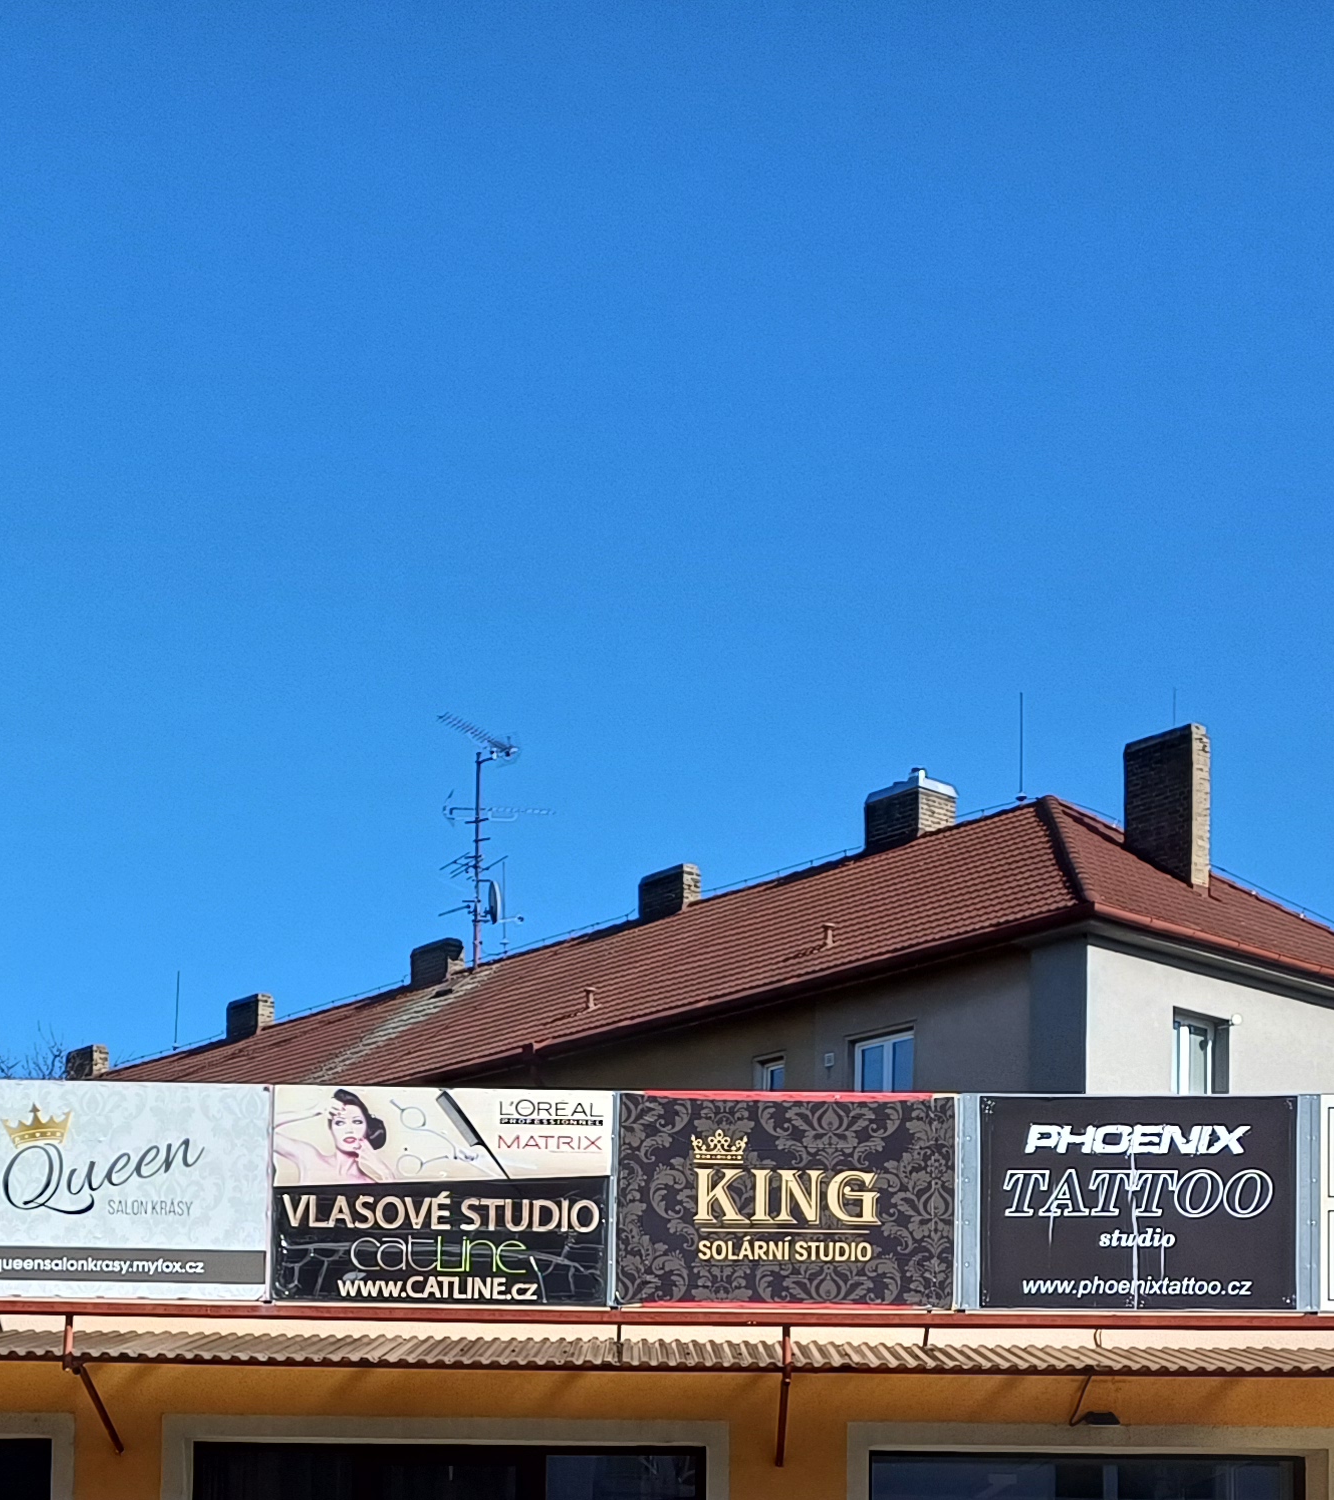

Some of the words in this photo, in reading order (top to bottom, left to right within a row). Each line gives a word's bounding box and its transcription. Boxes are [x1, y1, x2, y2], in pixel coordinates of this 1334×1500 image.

[499, 1117, 603, 1126] PROFESSIONNEL
[497, 1134, 603, 1151] MATRIX
[1024, 1123, 1252, 1155] PHOENIX
[2, 1137, 206, 1215] Queen
[693, 1167, 882, 1226] KING
[1002, 1168, 1274, 1219] TATTOO
[107, 1199, 148, 1216] SALON
[151, 1197, 194, 1217] KRÁSY
[283, 1191, 452, 1231] VLASOVÉ
[460, 1198, 601, 1234] STUDIO
[698, 1236, 792, 1260] SOLÁRNÍ
[795, 1240, 872, 1261] STUDIO
[1099, 1227, 1177, 1248] studio
[337, 1275, 538, 1300] www.CATLINE.cz
[1022, 1276, 1253, 1298] www.phoenixtattoo.cz
